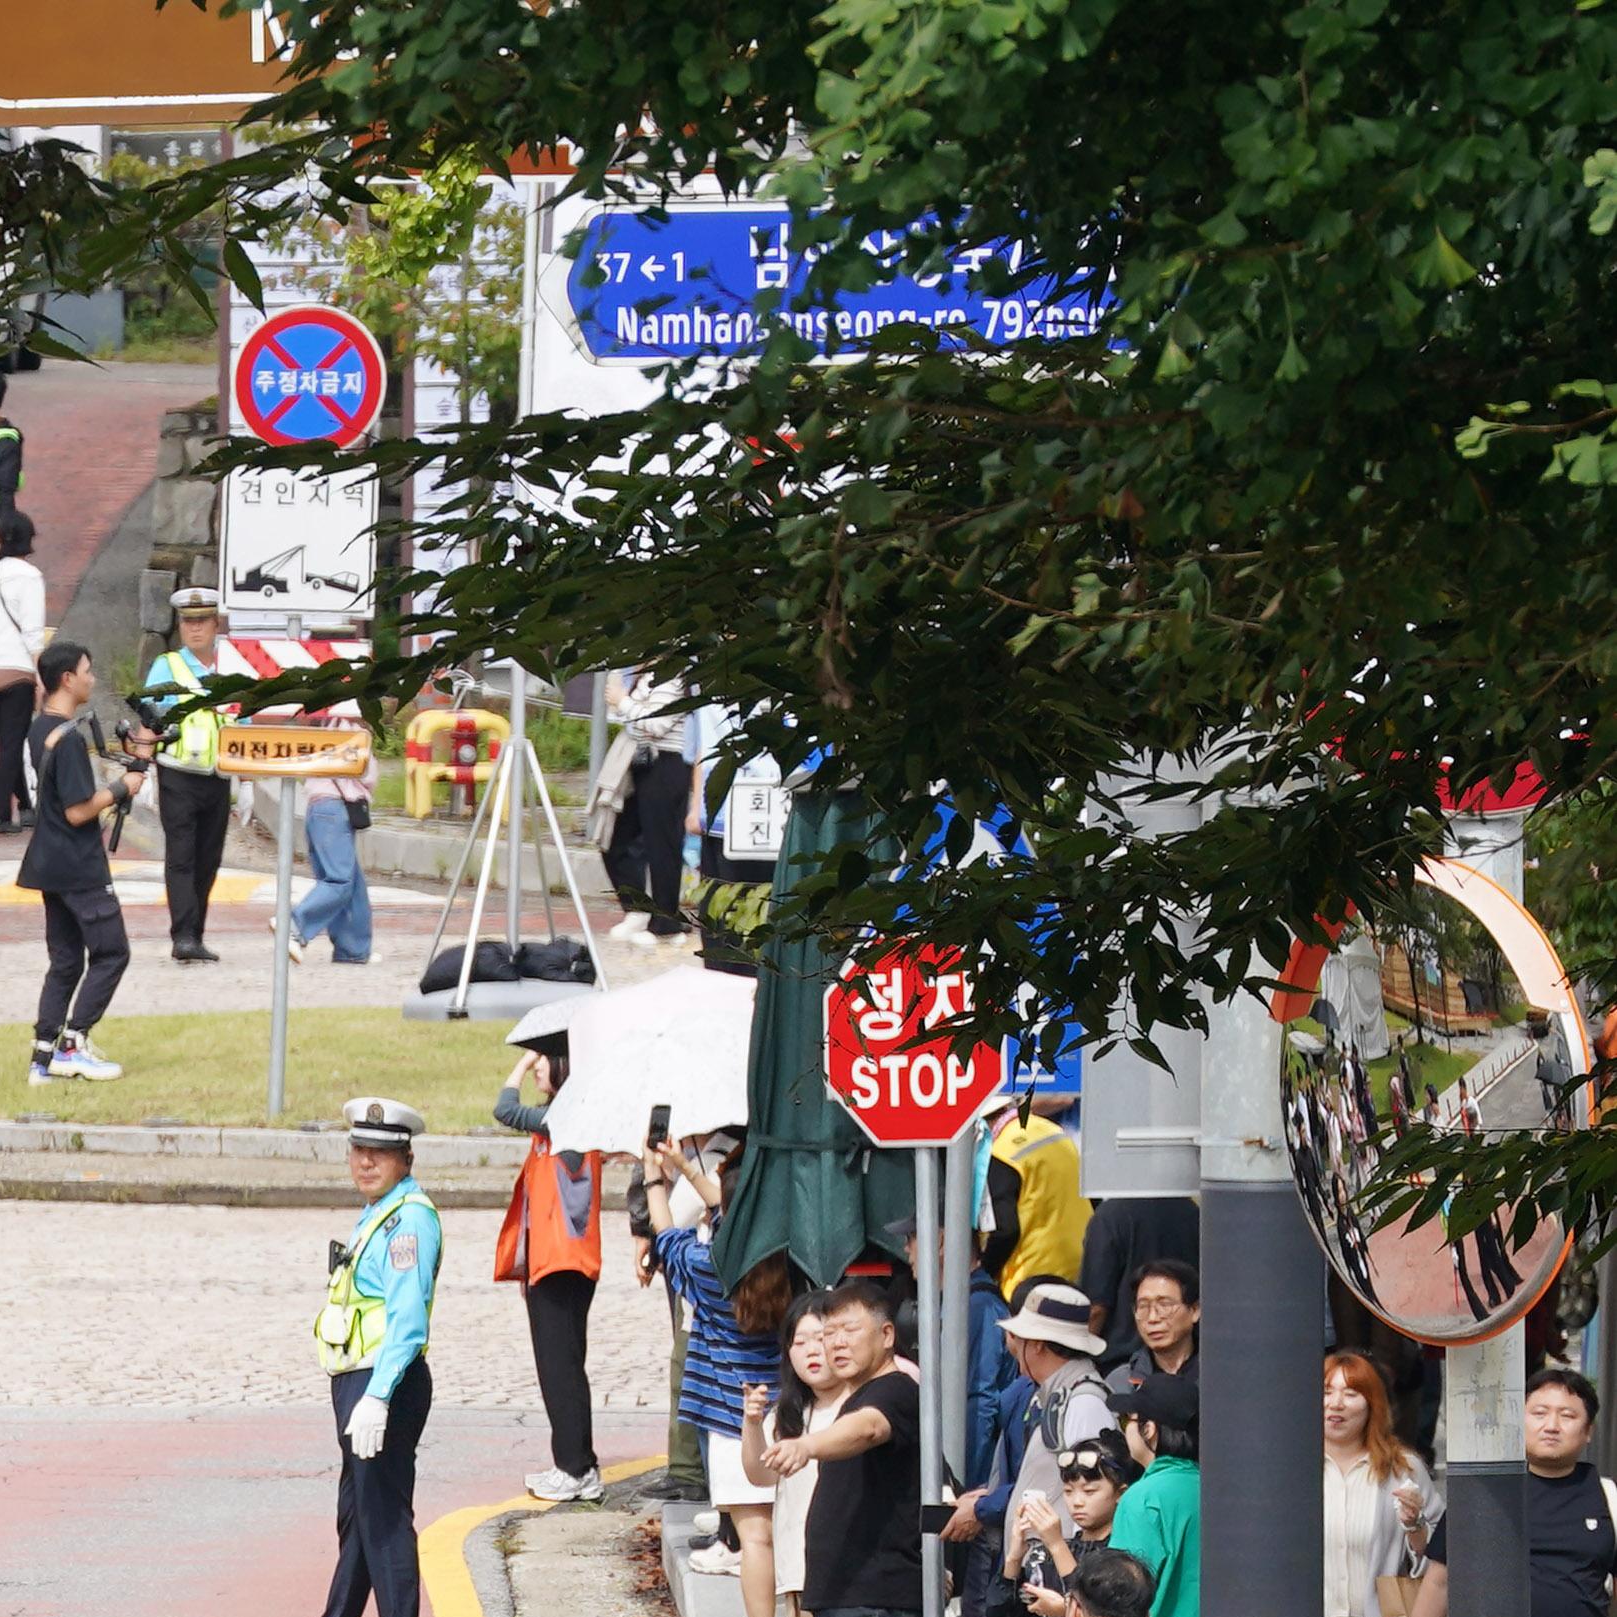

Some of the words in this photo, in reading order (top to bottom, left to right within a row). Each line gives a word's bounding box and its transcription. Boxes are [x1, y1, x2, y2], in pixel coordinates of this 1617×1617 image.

[671, 251, 685, 282] 1
[255, 369, 363, 396] 주정차금지
[239, 477, 365, 509] 견인지역
[850, 1053, 977, 1110] STOP
